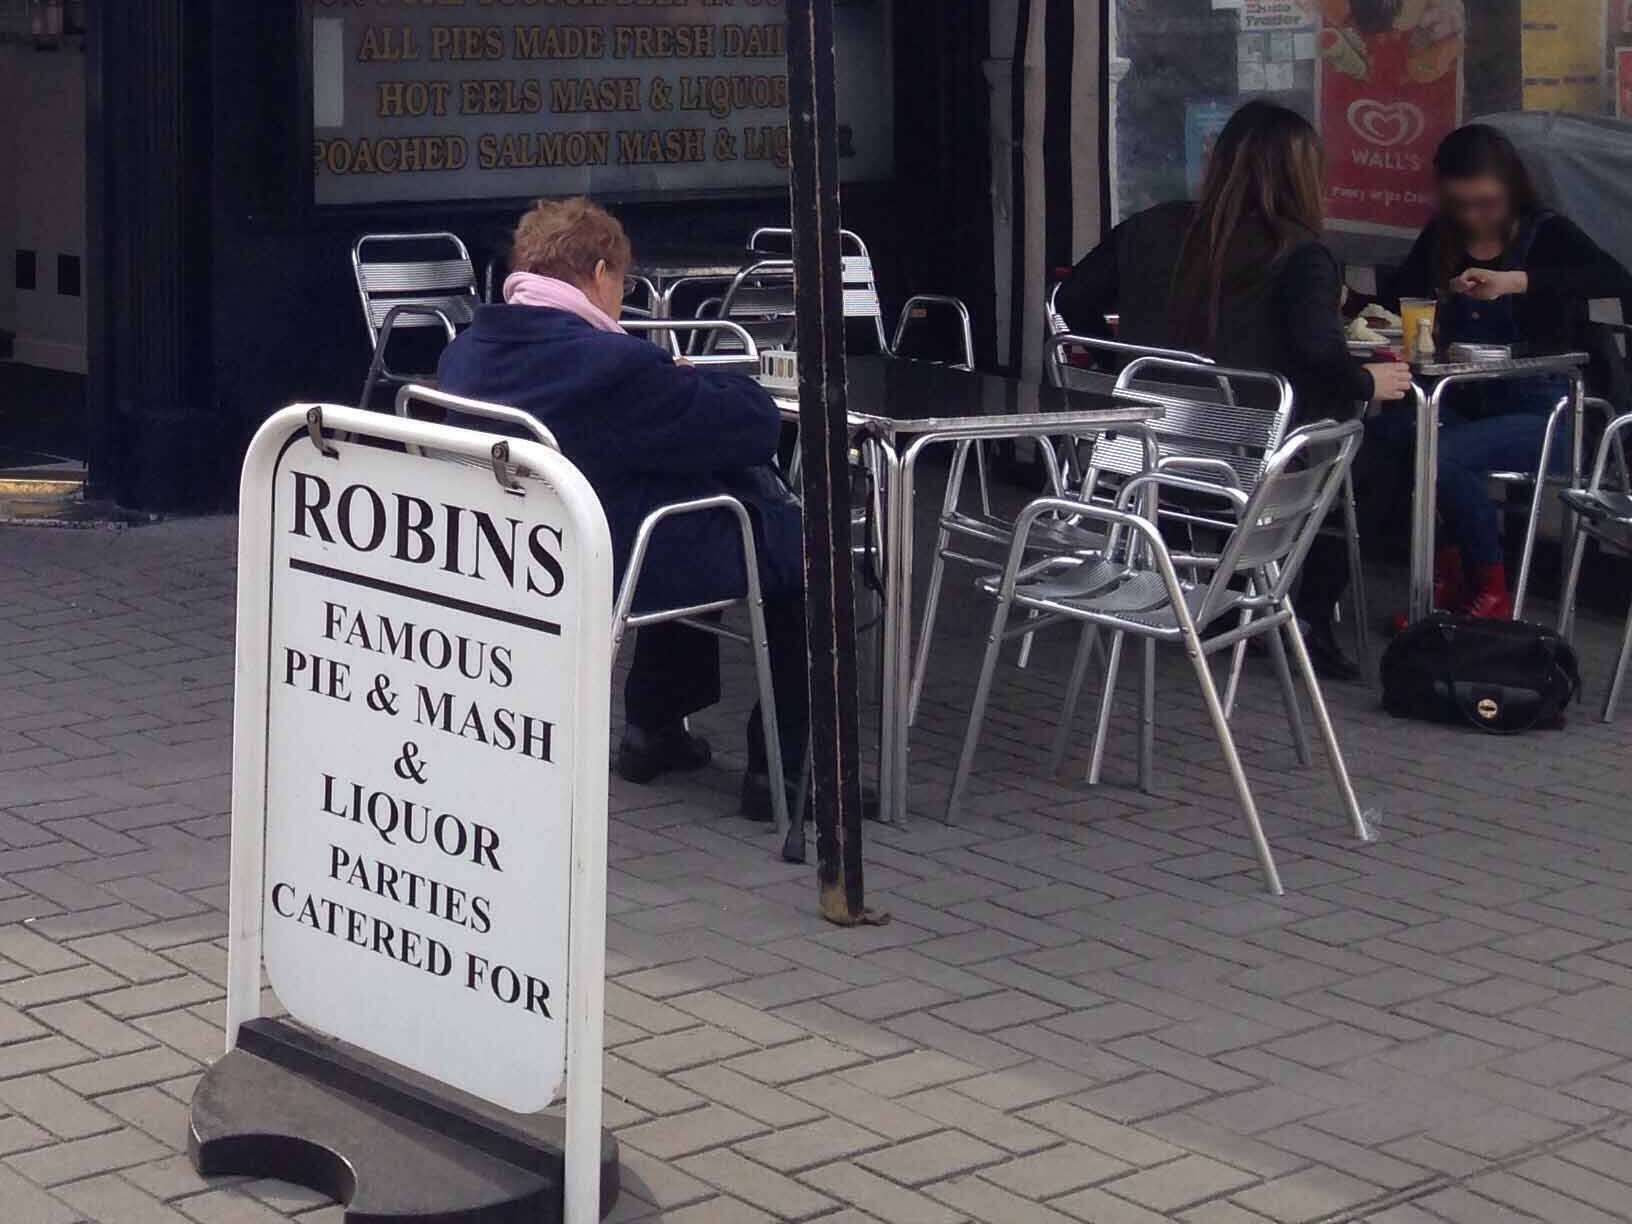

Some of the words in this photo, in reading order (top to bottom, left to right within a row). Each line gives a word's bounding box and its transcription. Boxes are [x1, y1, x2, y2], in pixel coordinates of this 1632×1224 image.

[357, 25, 418, 62] ALL
[430, 25, 505, 61] PIES
[513, 24, 604, 60] MADE
[615, 24, 715, 59] FRESH
[377, 80, 449, 118] HOT
[459, 79, 543, 116] EELS
[551, 77, 641, 113] MASH
[649, 77, 672, 112] &
[313, 135, 467, 175] POACHED
[479, 132, 609, 170] SALMON
[620, 126, 705, 164] MASH
[714, 127, 737, 161] &
[1352, 148, 1422, 171] WALL'S
[290, 470, 566, 598] ROBINS
[323, 600, 513, 688] FAMOUS
[283, 646, 352, 703] PIE
[367, 672, 400, 717] &
[415, 683, 555, 765] MASH
[394, 740, 429, 785] &
[321, 772, 504, 873] LIQUOR
[329, 843, 492, 934] PARTIES
[271, 881, 452, 978] CATERED
[465, 950, 554, 1021] FOR
